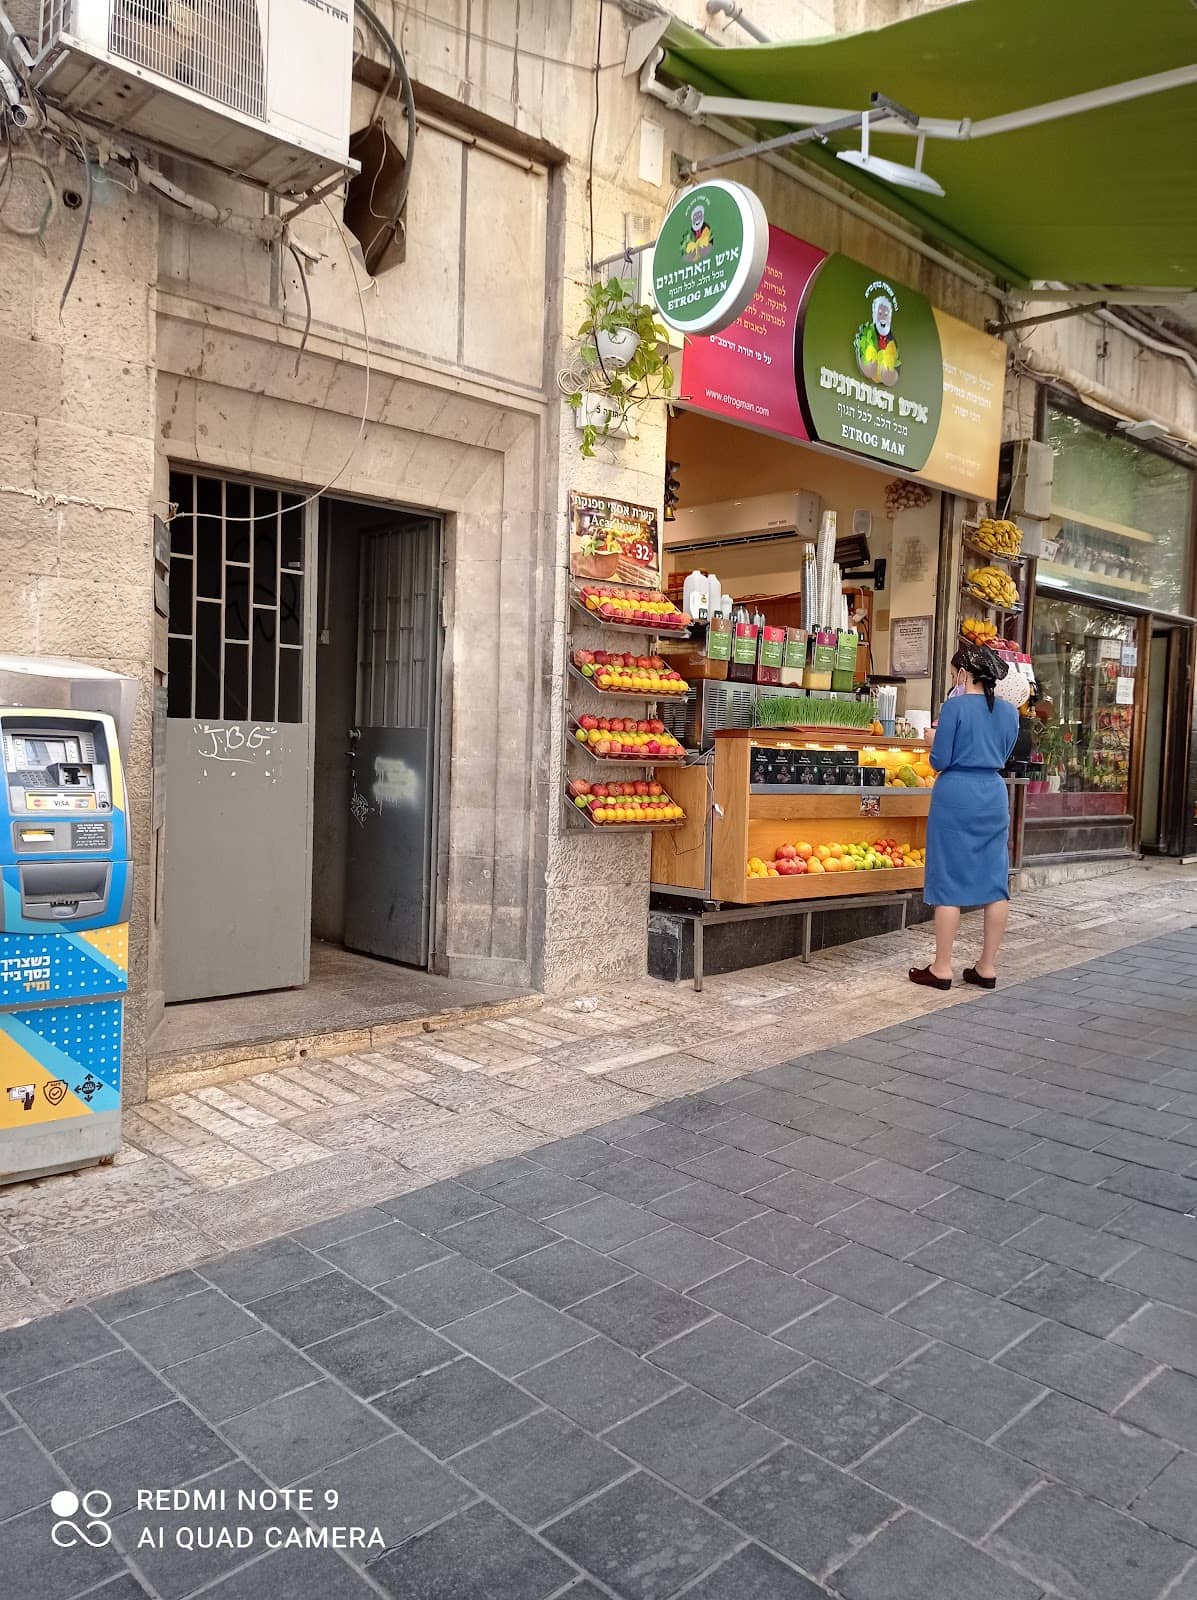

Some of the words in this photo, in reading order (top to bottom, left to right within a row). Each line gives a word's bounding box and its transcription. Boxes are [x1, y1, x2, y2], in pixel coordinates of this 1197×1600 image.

[303, 0, 348, 23] ECTRA
[716, 247, 739, 266] איש
[656, 259, 711, 289] האתרוגים
[712, 270, 725, 281] מכל
[669, 284, 683, 298] הגוף
[685, 279, 696, 292] לכל
[667, 291, 701, 310] ETROG
[703, 280, 727, 298] MAN
[737, 344, 754, 357] תורת
[755, 351, 762, 361] פי
[764, 352, 772, 364] על
[820, 366, 895, 412] האתרוגים
[705, 388, 770, 417] www.etrogman.com
[837, 402, 856, 419] הגוף
[899, 396, 928, 424] איש
[857, 407, 872, 424] לכל
[893, 421, 908, 436] מכל
[842, 424, 878, 448] ETROG
[881, 435, 905, 457] MAN
[575, 496, 605, 511] מפנקת
[632, 507, 655, 525] קערת
[0, 955, 50, 971] כשצריך
[0, 970, 22, 982] ביד
[24, 968, 50, 981] כסף
[23, 980, 50, 992] ומיד
